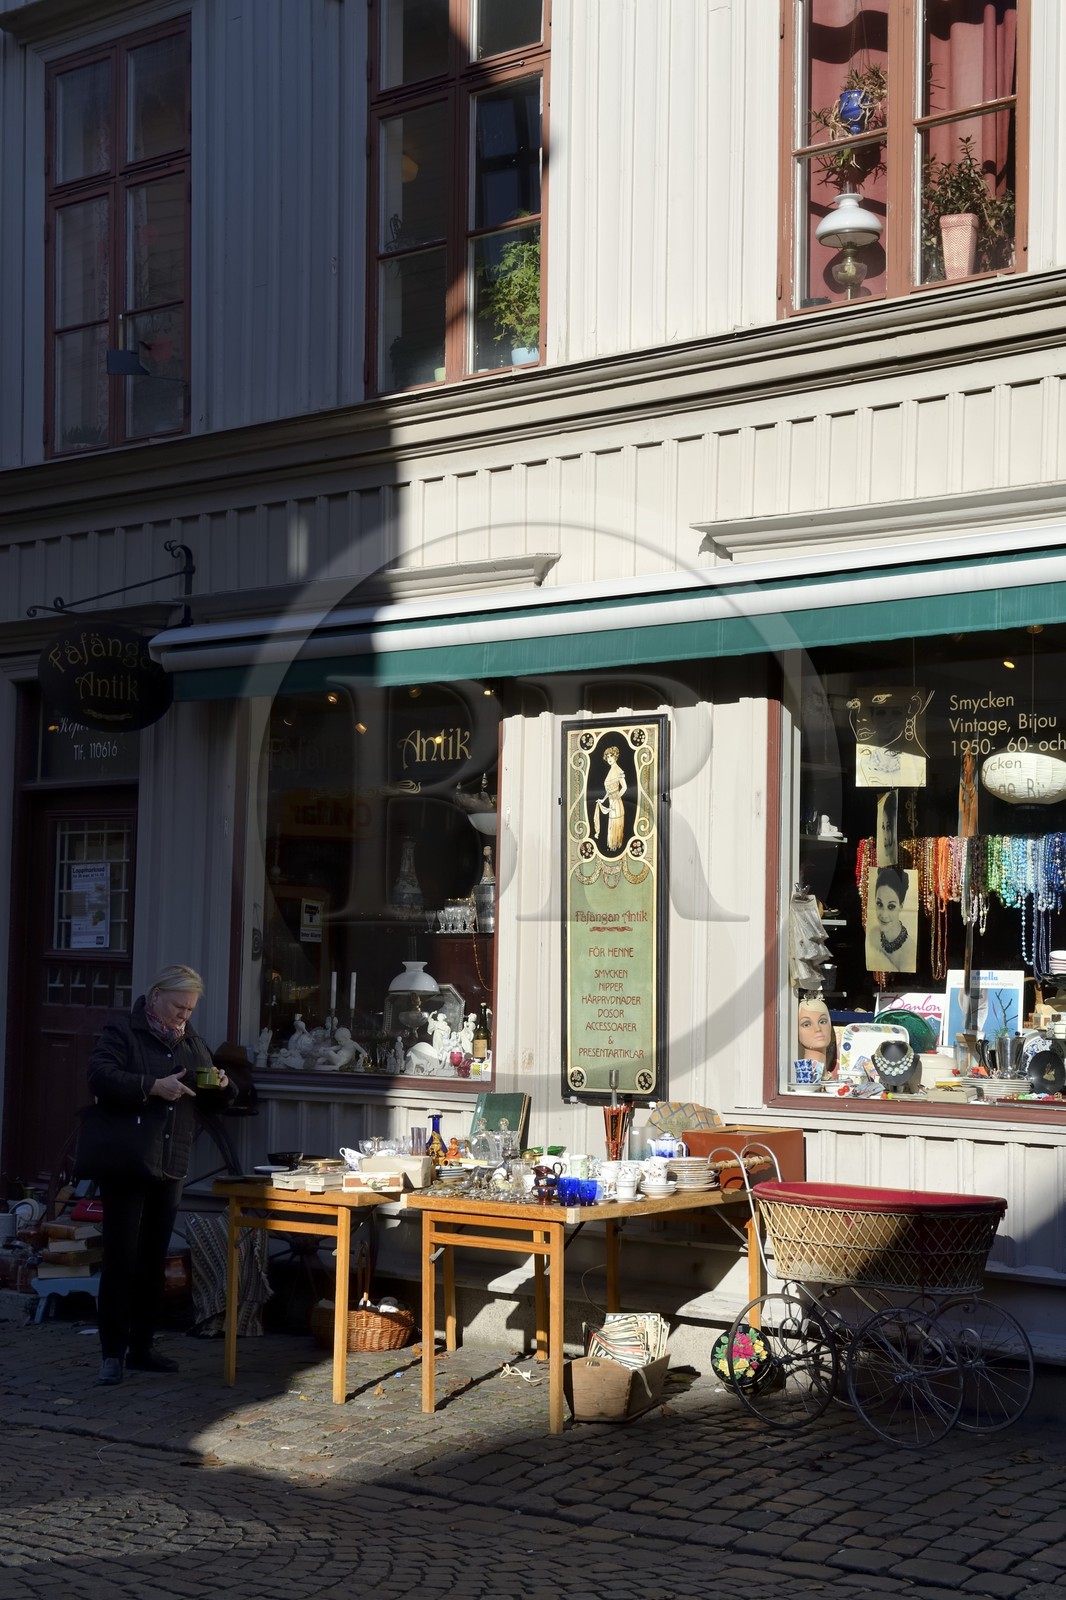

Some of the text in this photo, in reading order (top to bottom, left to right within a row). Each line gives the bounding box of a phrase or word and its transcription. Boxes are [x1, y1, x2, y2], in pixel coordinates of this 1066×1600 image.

[75, 671, 140, 702] Antik
[949, 690, 1014, 714] Smycken
[949, 713, 1057, 736] Vintage, Bijou
[90, 740, 118, 760] 110616
[396, 727, 472, 770] Antik
[951, 733, 1066, 757] 1950- 60- och
[575, 910, 648, 925] Fåfängan Antik
[588, 945, 634, 957] FÖR HENNE
[594, 969, 628, 979] SMYCKEN
[598, 982, 624, 992] NIPPER
[581, 993, 641, 1005] HÅRPRYDNADER
[597, 1008, 625, 1018] DOSOR
[585, 1021, 637, 1032] ACCESSOARER
[607, 1035, 614, 1045] &
[578, 1047, 645, 1059] PRESENTARTIKLAR
